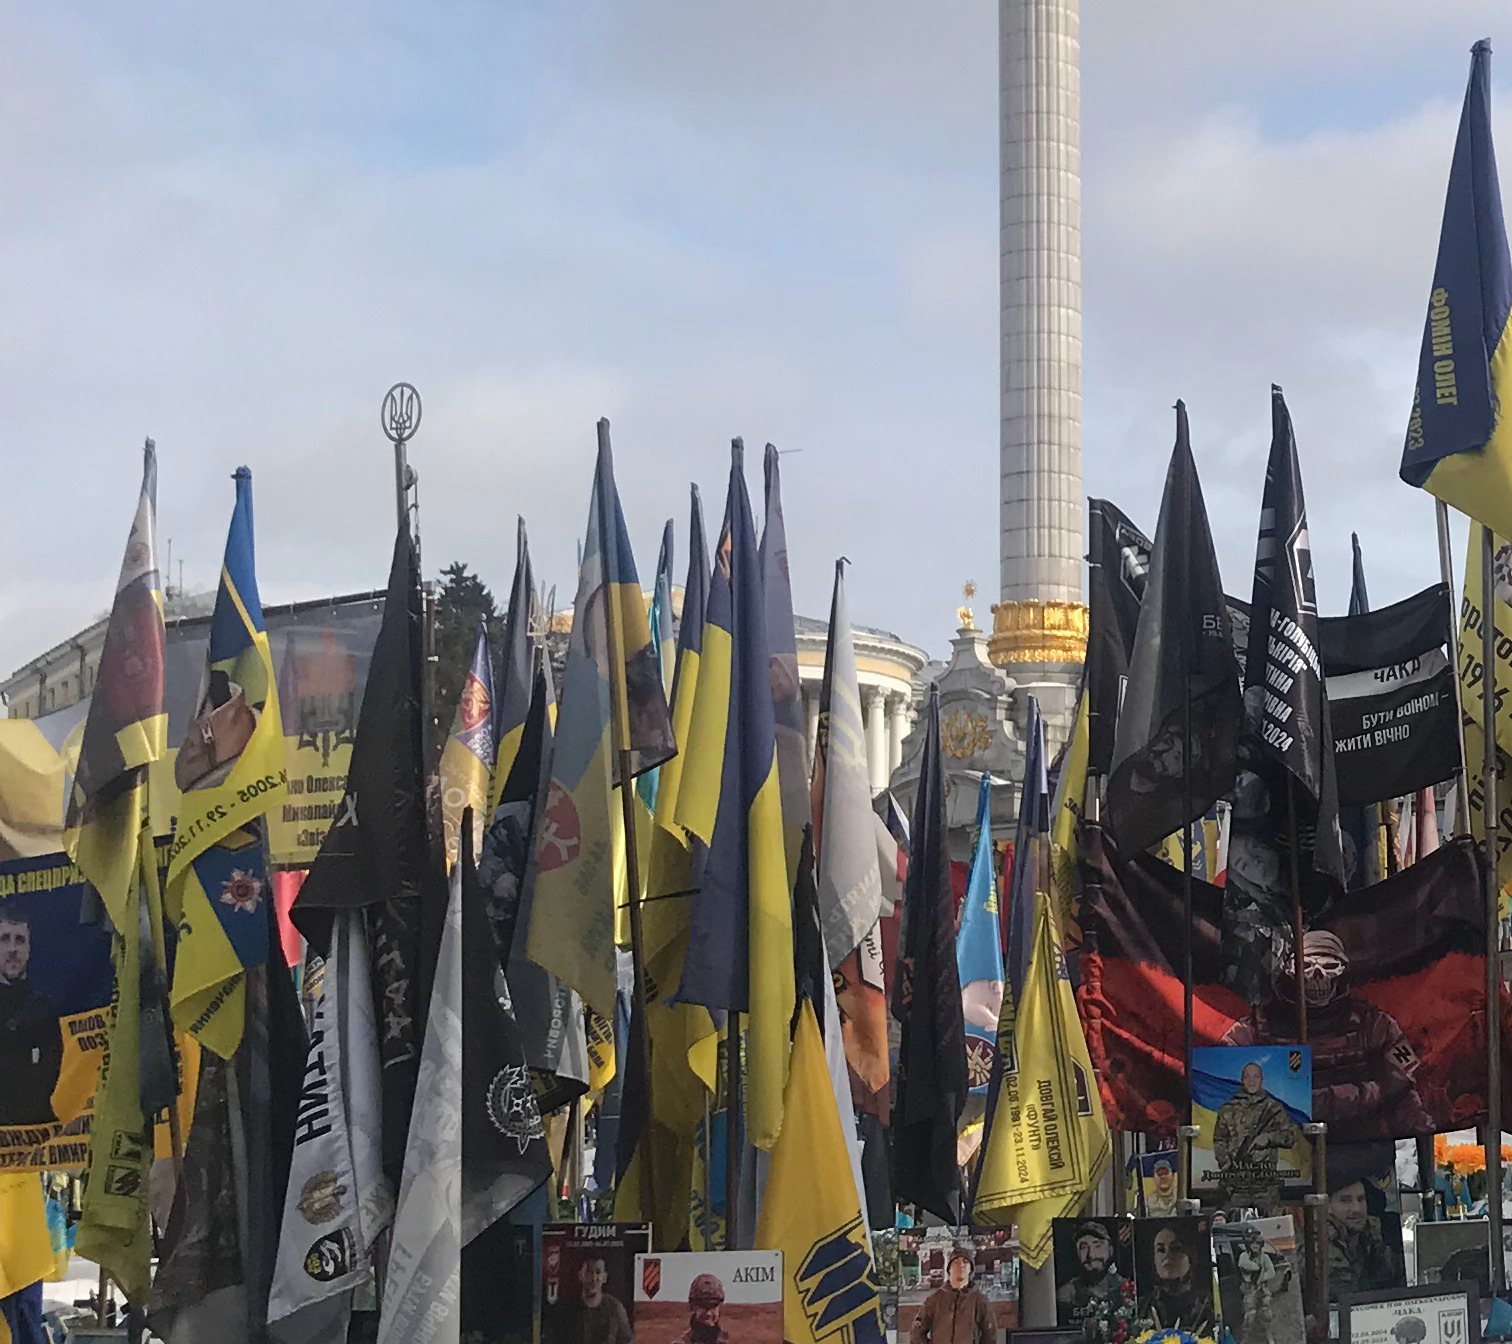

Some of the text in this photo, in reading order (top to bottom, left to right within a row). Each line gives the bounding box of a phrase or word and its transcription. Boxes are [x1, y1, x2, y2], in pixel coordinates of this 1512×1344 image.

[1430, 287, 1458, 406] ФОМІН ОЛЕГ
[1362, 710, 1394, 730] БУТИ
[1335, 724, 1410, 753] ЖИТИ ВІЧНО
[1025, 1102, 1042, 1152] «ФУНТ»
[1037, 1079, 1066, 1171] ДОВГАЙ ОЛЕКСІЙ
[574, 1224, 617, 1240] ГУДИМ
[732, 1265, 776, 1284] АКІМ
